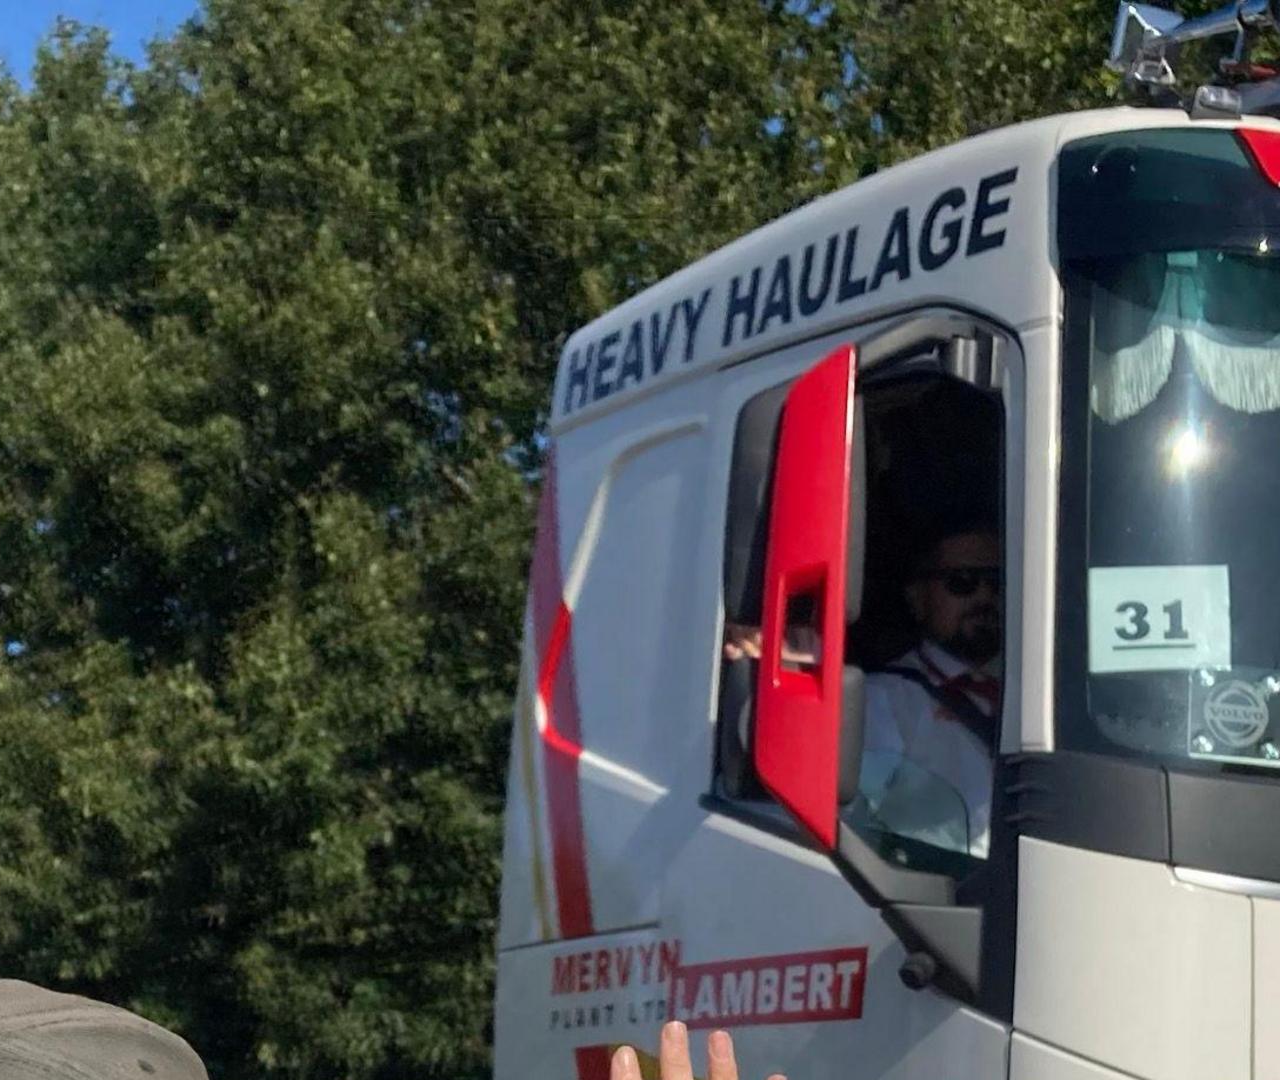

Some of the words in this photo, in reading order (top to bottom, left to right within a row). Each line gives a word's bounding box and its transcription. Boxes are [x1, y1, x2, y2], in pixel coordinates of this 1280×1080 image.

[562, 290, 711, 413] HEAVY
[722, 167, 1018, 346] HAULAGE
[1114, 599, 1189, 641] 31
[552, 939, 682, 995] MERVYN
[675, 960, 859, 1020] LAMBERT
